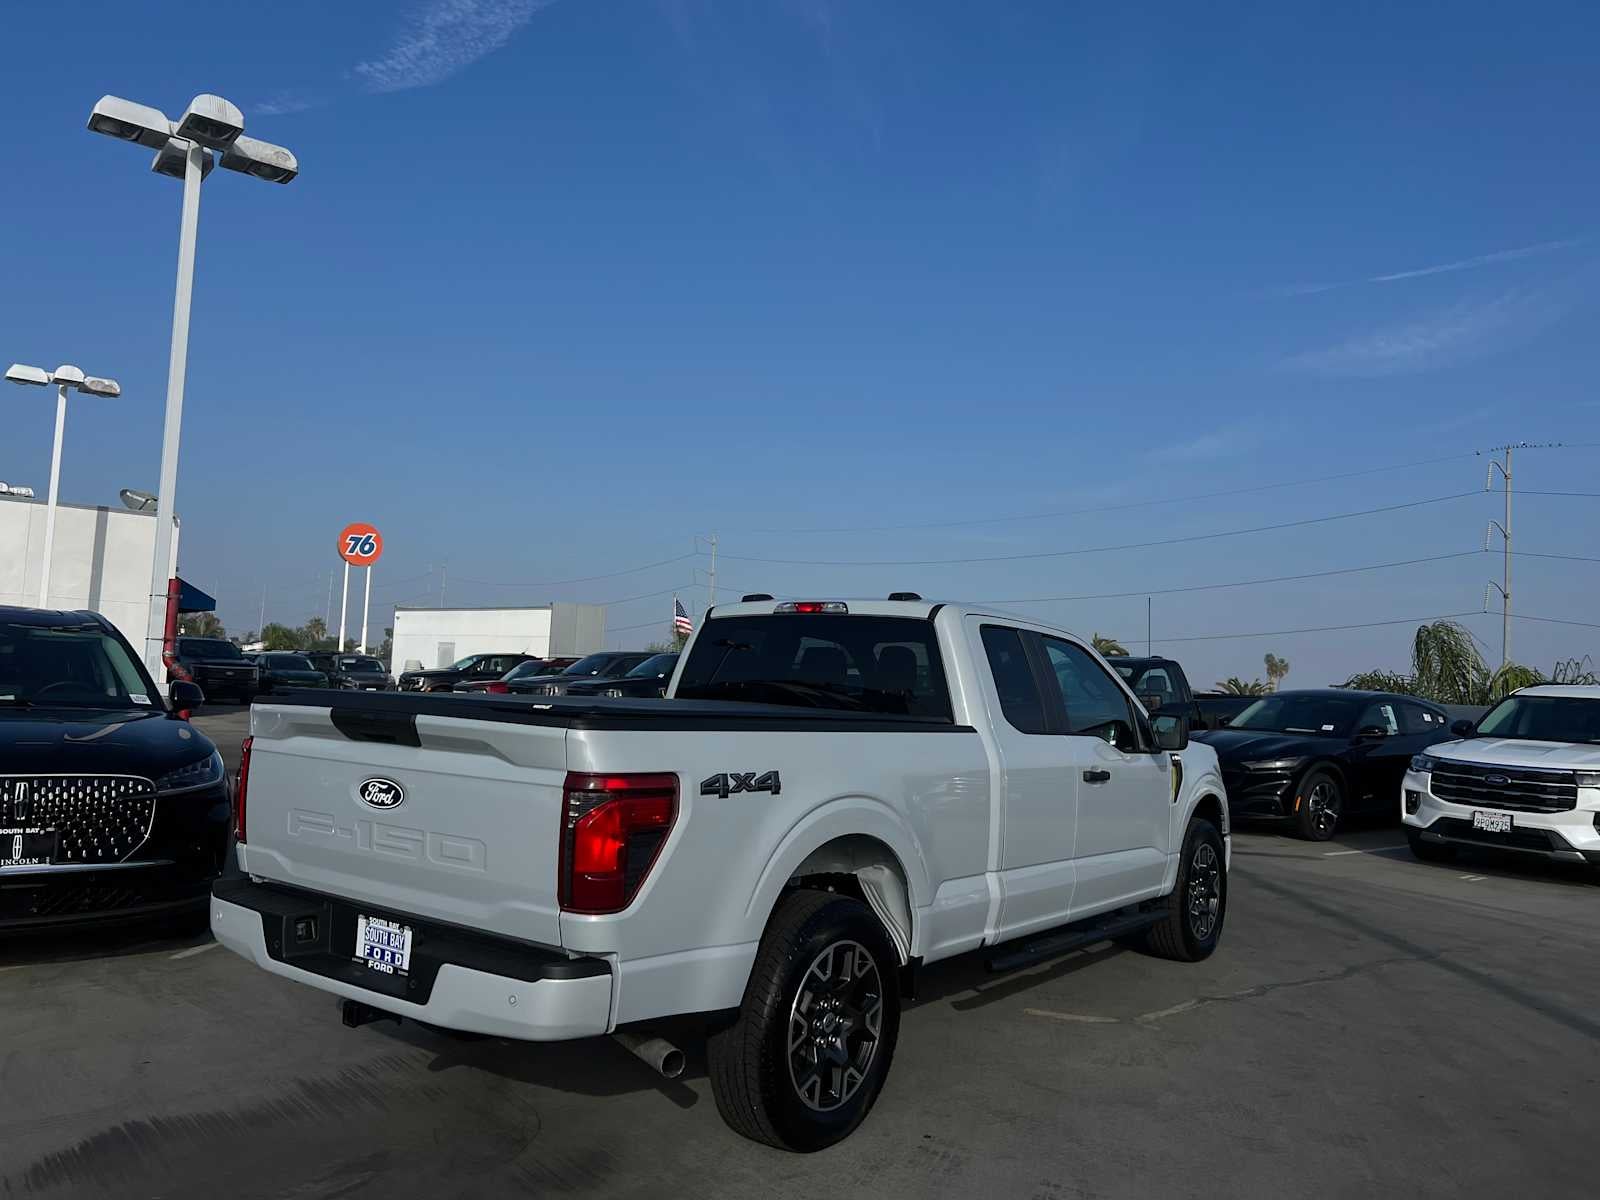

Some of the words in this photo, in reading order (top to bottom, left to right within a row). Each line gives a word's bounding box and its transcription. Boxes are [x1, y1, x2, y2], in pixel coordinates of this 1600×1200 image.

[345, 532, 377, 557] 76
[364, 781, 396, 805] Ford
[287, 807, 487, 873] F-150
[0, 857, 39, 865] INCOLN
[389, 921, 400, 930] BAY
[366, 927, 388, 945] SOUTH
[390, 933, 404, 950] BAY
[364, 945, 403, 965] FORD
[368, 960, 394, 974] FORD
